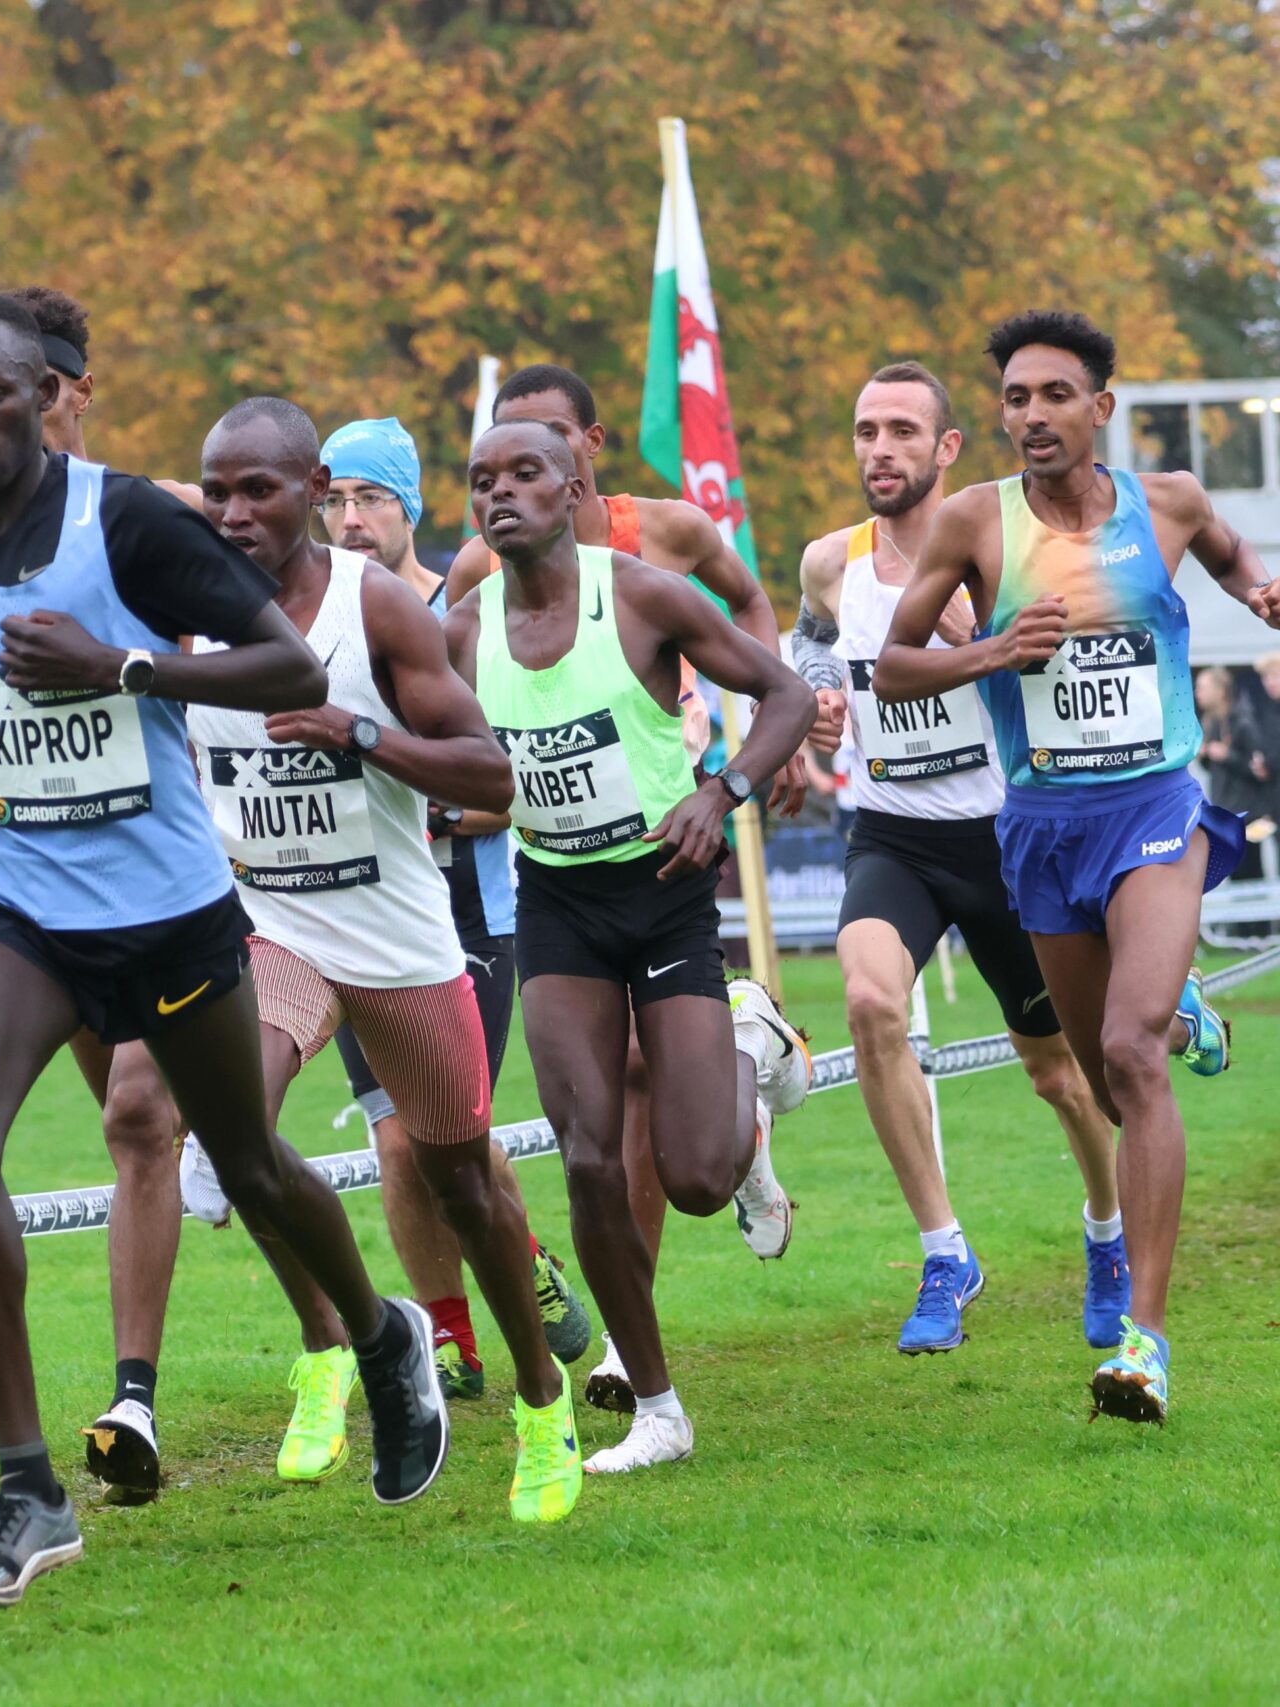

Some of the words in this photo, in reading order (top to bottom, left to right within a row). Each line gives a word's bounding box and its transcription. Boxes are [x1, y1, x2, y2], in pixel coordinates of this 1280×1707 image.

[1101, 544, 1141, 566] HOKA
[1076, 657, 1098, 668] CROSS
[1099, 653, 1136, 665] CHALLENGE
[27, 690, 55, 701] CROSS
[1053, 676, 1130, 721] GIDEY
[535, 746, 557, 759] CROSS
[558, 736, 597, 754] CHALLENGE
[266, 771, 291, 781] CROSS
[292, 768, 336, 780] CHALLENGE
[519, 761, 597, 807] KIBET
[239, 792, 336, 839] MUTAI
[1142, 837, 1183, 856] HOKA
